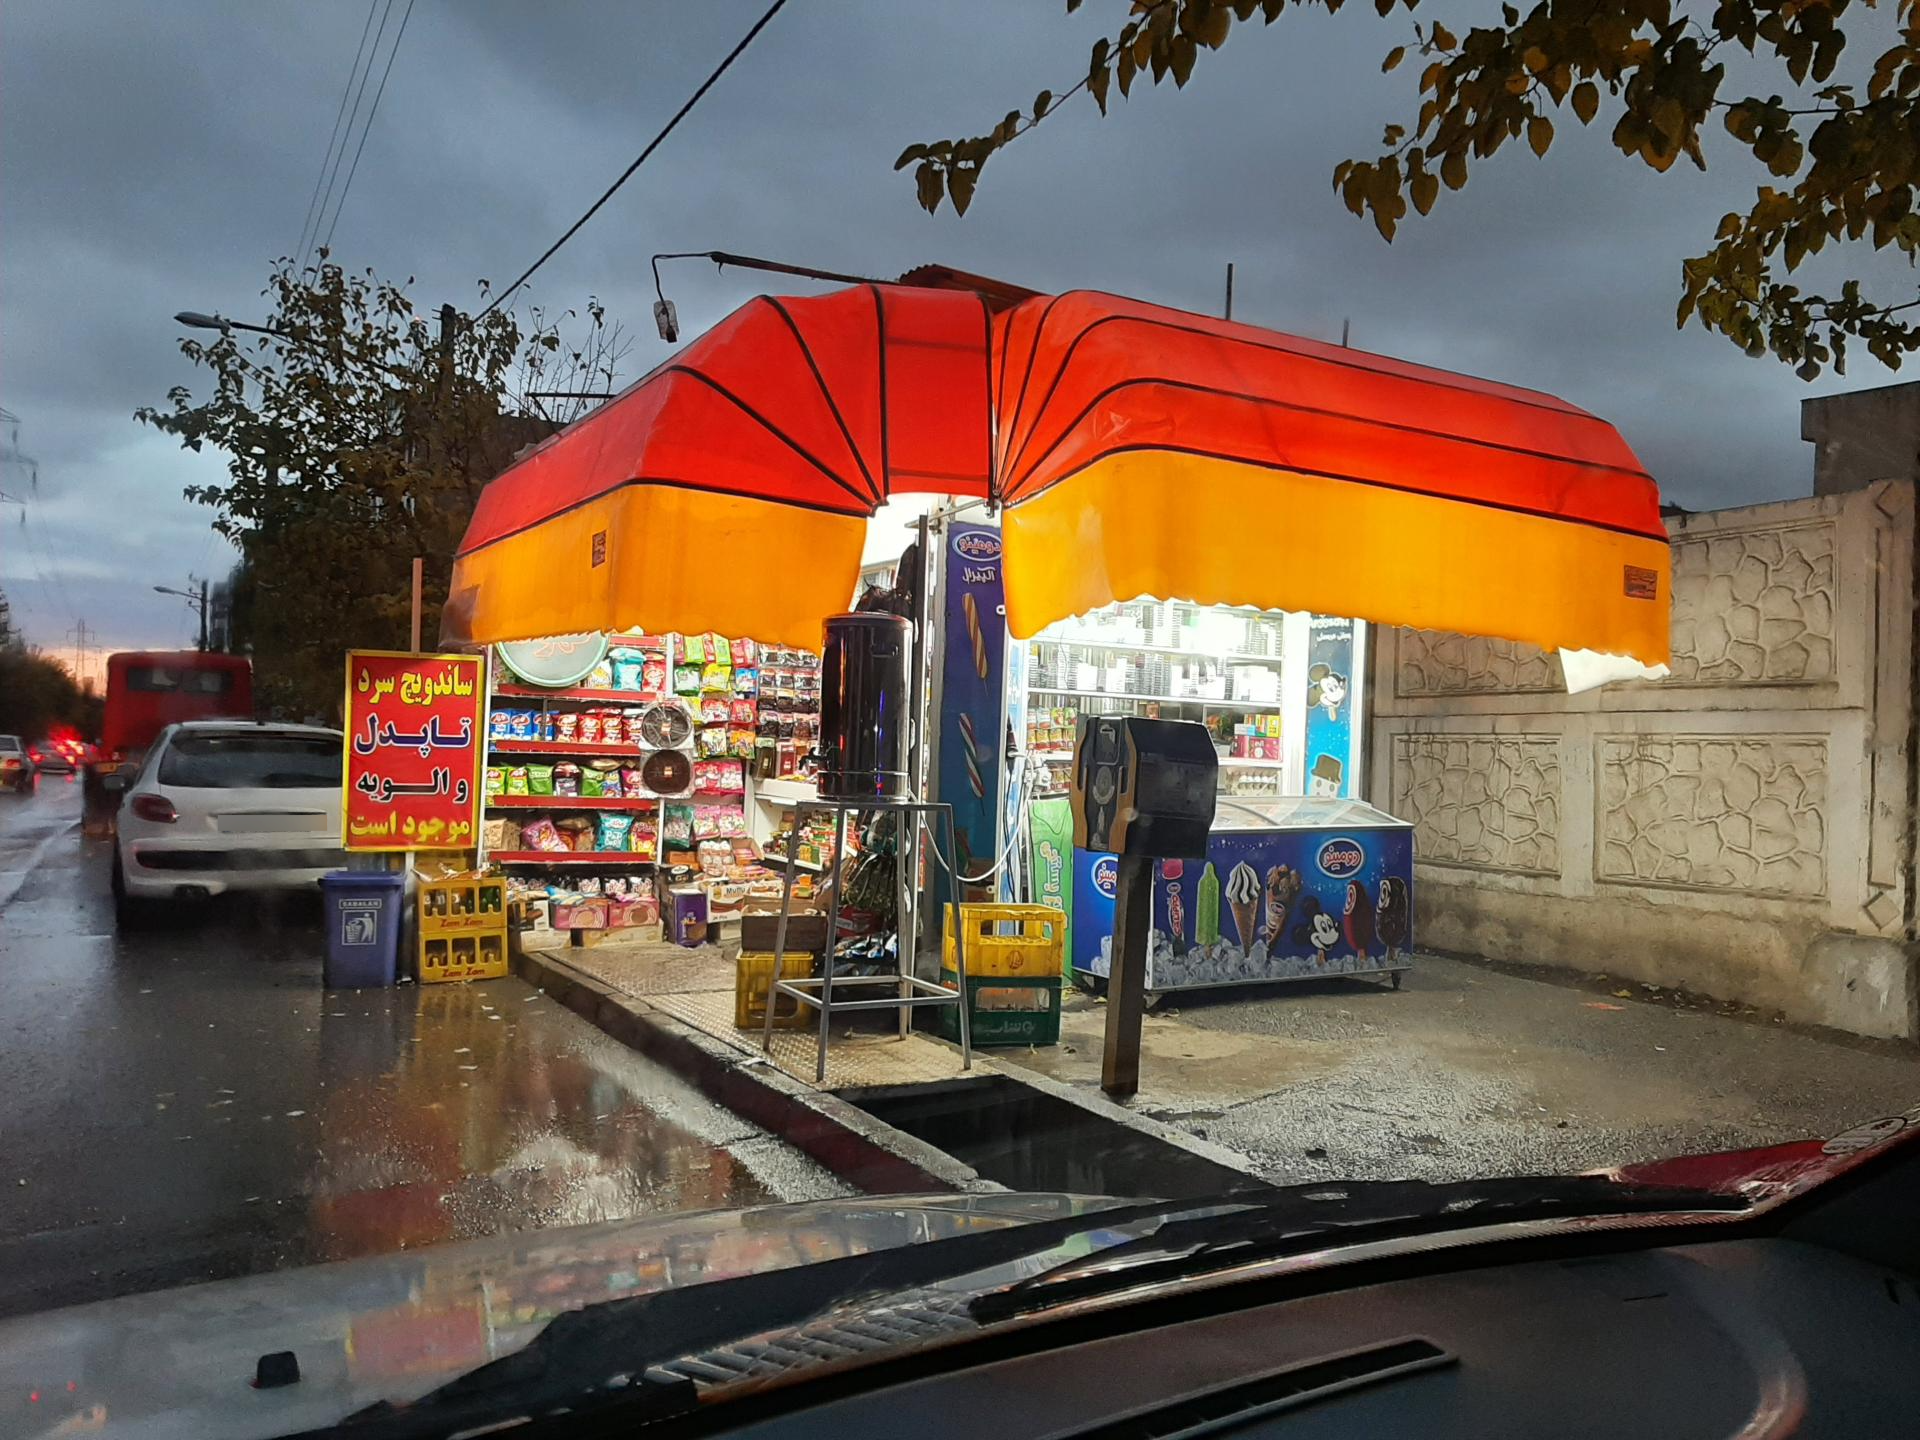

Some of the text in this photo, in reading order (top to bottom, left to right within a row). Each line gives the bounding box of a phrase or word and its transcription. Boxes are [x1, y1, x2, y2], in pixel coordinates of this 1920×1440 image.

[358, 663, 473, 705] ساندویچ سرد
[354, 712, 472, 758] تاپدل
[356, 766, 469, 804] و الویه
[350, 810, 470, 842] موجود است
[1323, 845, 1361, 871] دومینو
